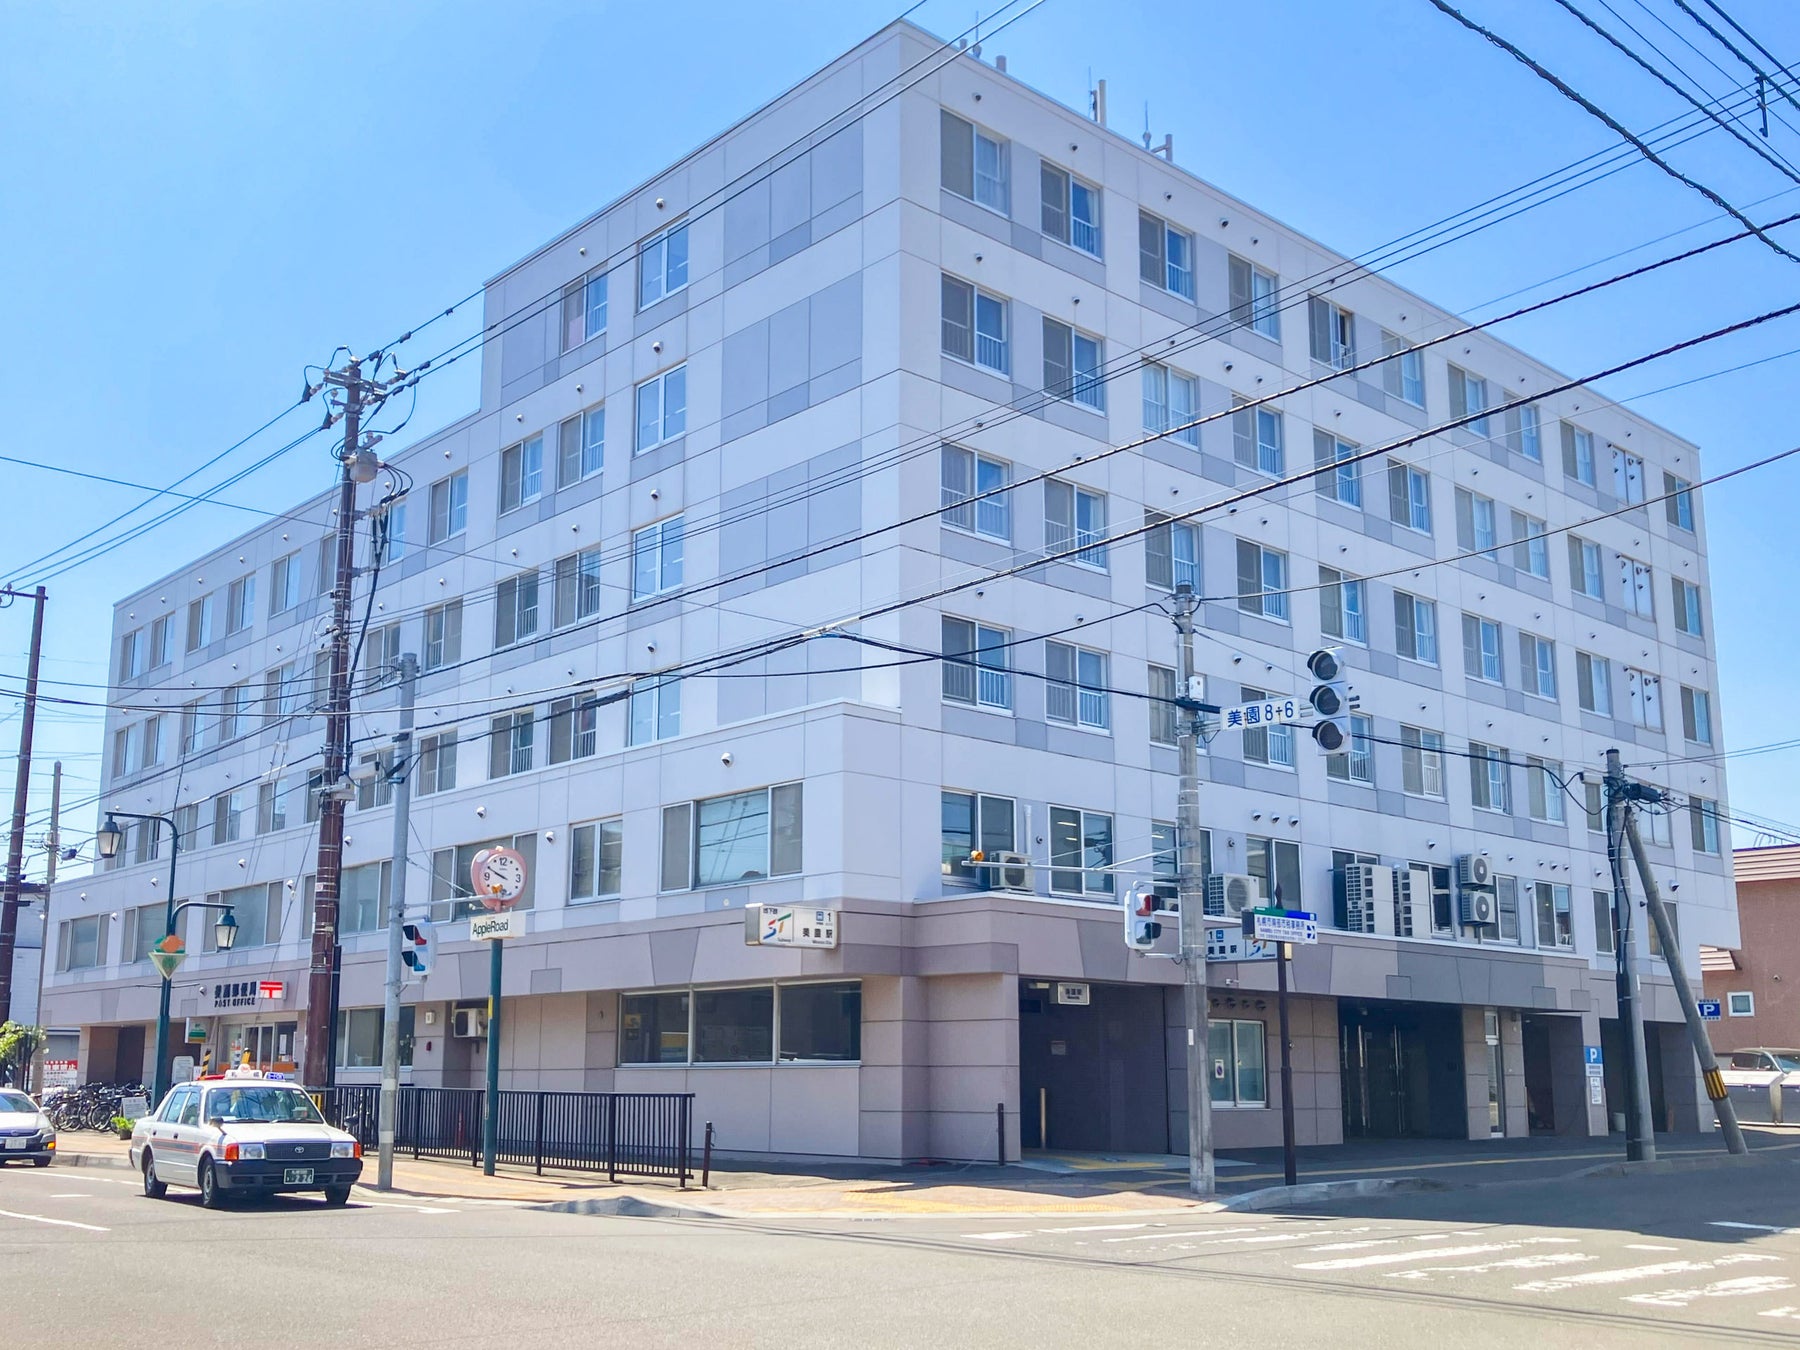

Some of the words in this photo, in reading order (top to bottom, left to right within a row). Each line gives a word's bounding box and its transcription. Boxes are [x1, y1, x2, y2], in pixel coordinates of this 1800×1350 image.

[499, 857, 507, 866] 12
[484, 872, 490, 881] 9
[515, 874, 521, 883] 3
[214, 998, 231, 1008] POST
[232, 997, 256, 1006] OFFICE
[1703, 1004, 1715, 1016] P
[1590, 1048, 1598, 1063] P
